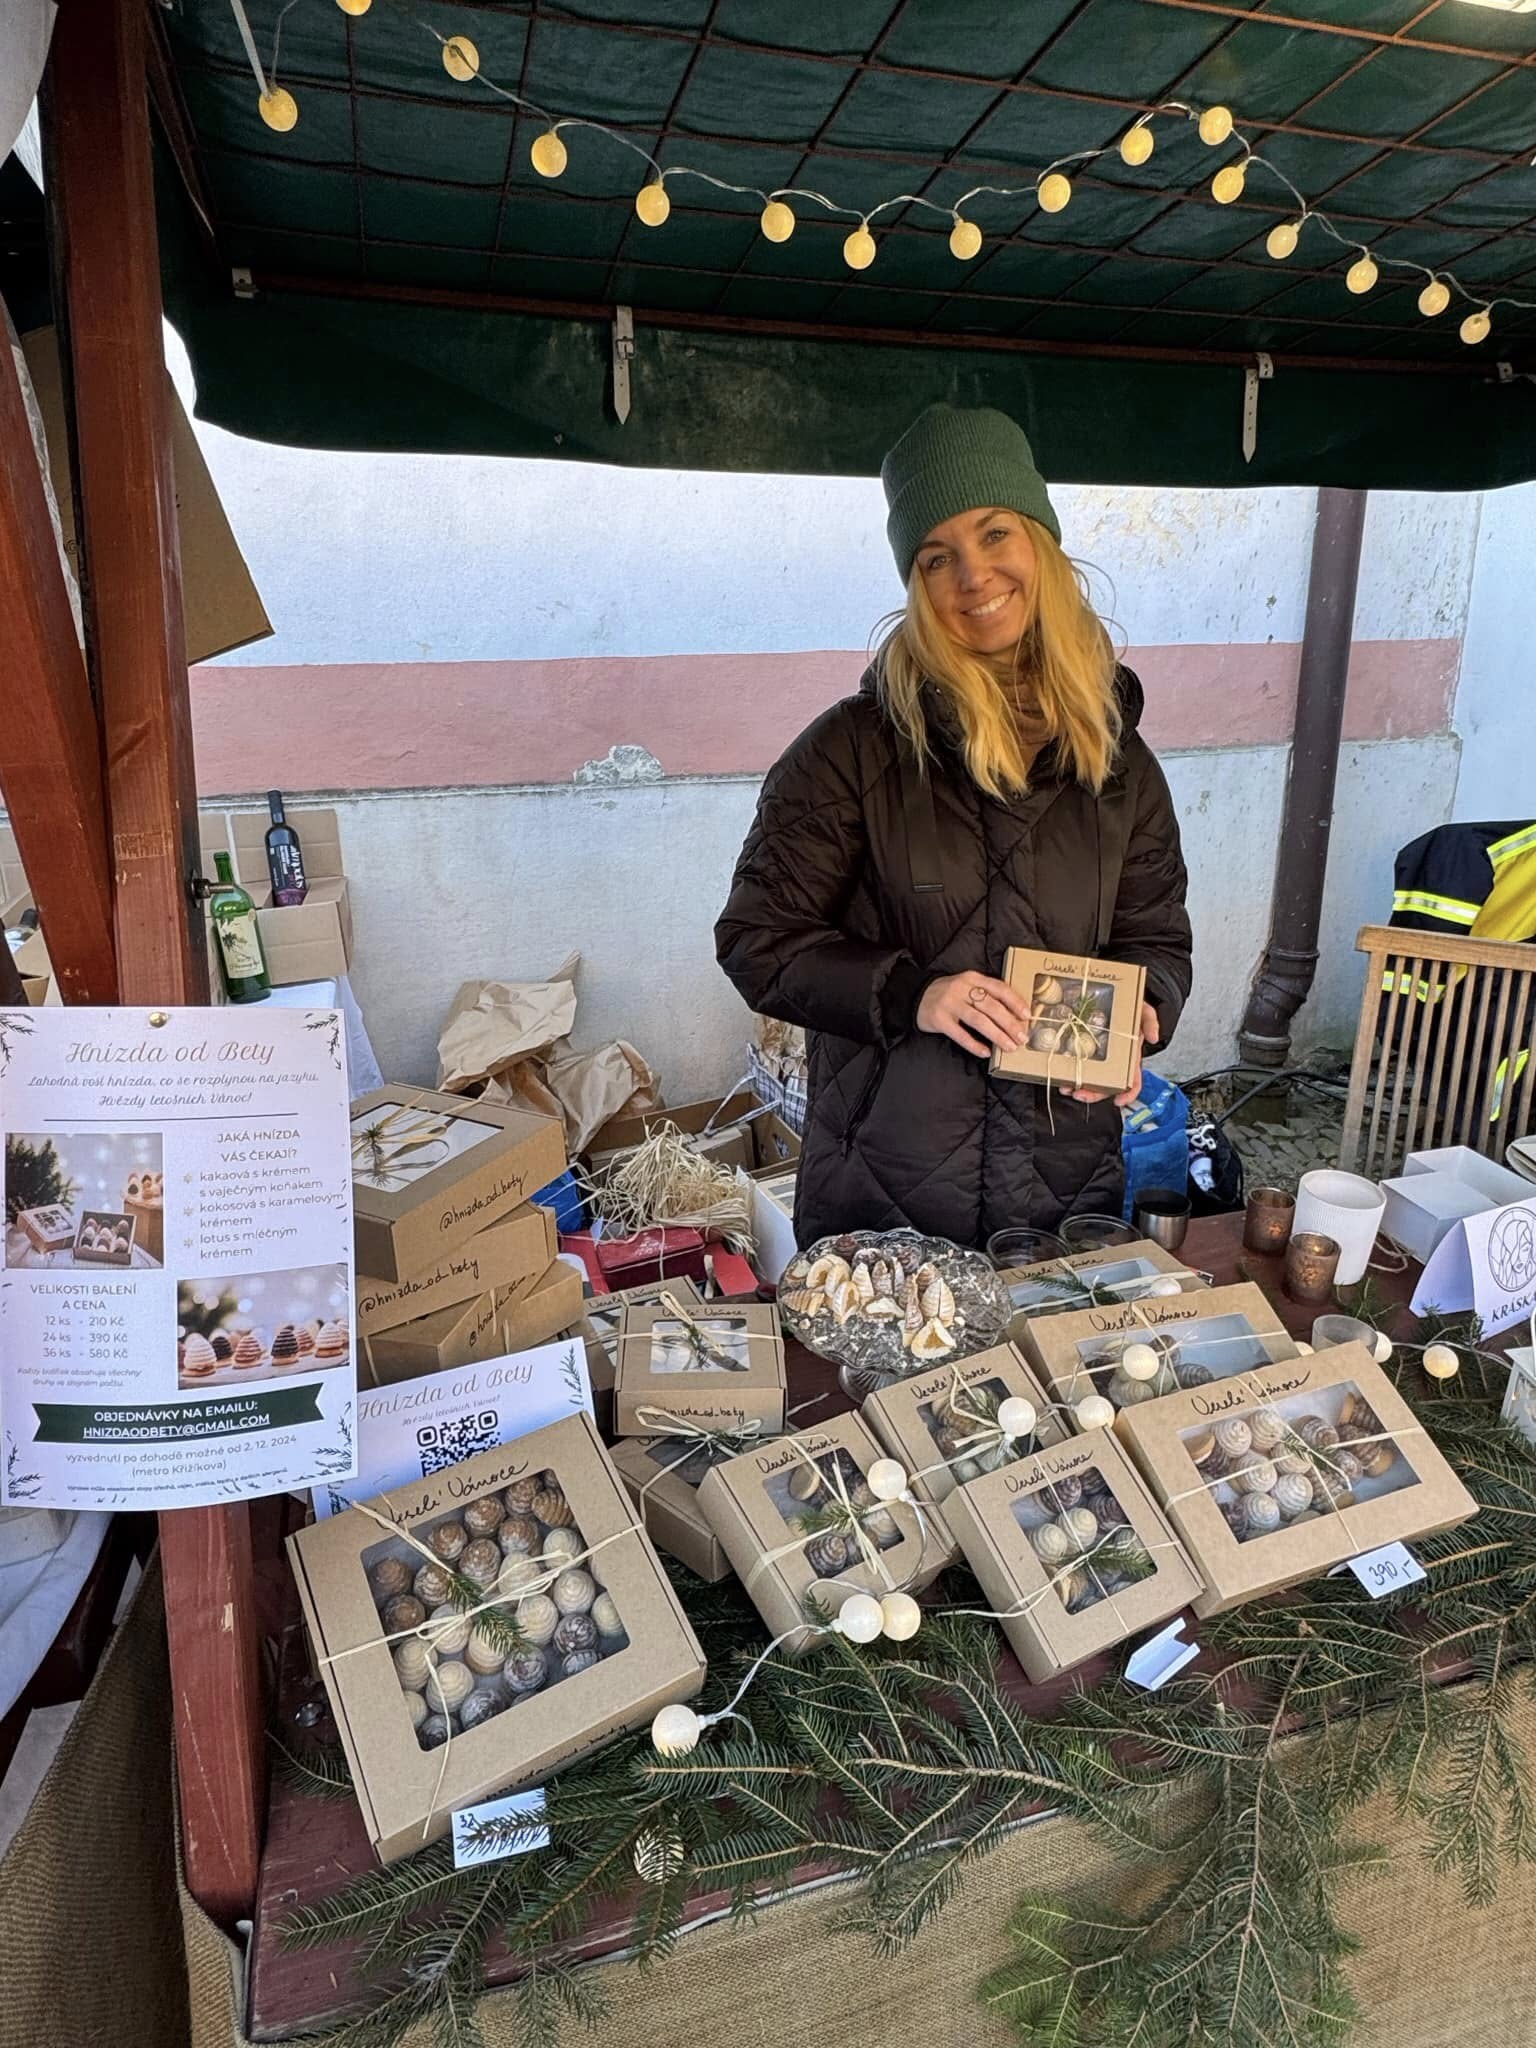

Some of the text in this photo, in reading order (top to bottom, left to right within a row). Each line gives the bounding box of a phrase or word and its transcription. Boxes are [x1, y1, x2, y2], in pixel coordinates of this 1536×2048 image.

[66, 1041, 275, 1064] Hnízda od Bety
[28, 1076, 82, 1087] Lahodná
[159, 1077, 173, 1087] co
[177, 1076, 190, 1087] se
[193, 1073, 257, 1087] rozplynou
[258, 1074, 275, 1084] na
[275, 1072, 319, 1085] jazyku.
[99, 1092, 253, 1108] Hvězdy letošních Vánoc!
[217, 1129, 300, 1143] JAKÁ HNÍZDA
[221, 1149, 297, 1162] VÁS ČEKAJÍ?
[200, 1166, 310, 1182] kakaová s krémem
[200, 1180, 323, 1198] s vaječným koňakem
[200, 1193, 343, 1213] kokosová s karamelovým
[200, 1217, 252, 1229] krémem
[200, 1227, 297, 1244] lotus s mléčným
[200, 1248, 253, 1260] krémem
[30, 1283, 137, 1295] VELIKOSTI BALENÍ
[62, 1300, 107, 1310] A CENA
[46, 1315, 56, 1326] 12
[59, 1316, 71, 1326] ks
[89, 1316, 107, 1327] 210
[110, 1316, 125, 1327] Kč
[43, 1332, 57, 1342] 24
[60, 1332, 71, 1342] ks
[89, 1333, 111, 1343] 390
[113, 1333, 128, 1343] Kč
[43, 1347, 57, 1358] 36
[60, 1348, 71, 1358] ks
[89, 1348, 111, 1359] 580
[113, 1348, 129, 1359] Kč
[359, 1364, 533, 1422] Hnízda od Bety
[94, 1400, 259, 1422] OBJEDNÁVKY NA EMAILU:
[82, 1413, 270, 1439] HNIZDAODBETY@GMAIL.COM
[123, 1455, 138, 1466] po
[140, 1450, 183, 1463] dohodě
[186, 1448, 225, 1460] možné
[227, 1444, 242, 1454] od
[243, 1442, 253, 1452] 2.
[255, 1440, 269, 1449] 12.
[271, 1434, 297, 1447] 2024
[131, 1459, 227, 1479] (metro Křižíkova)
